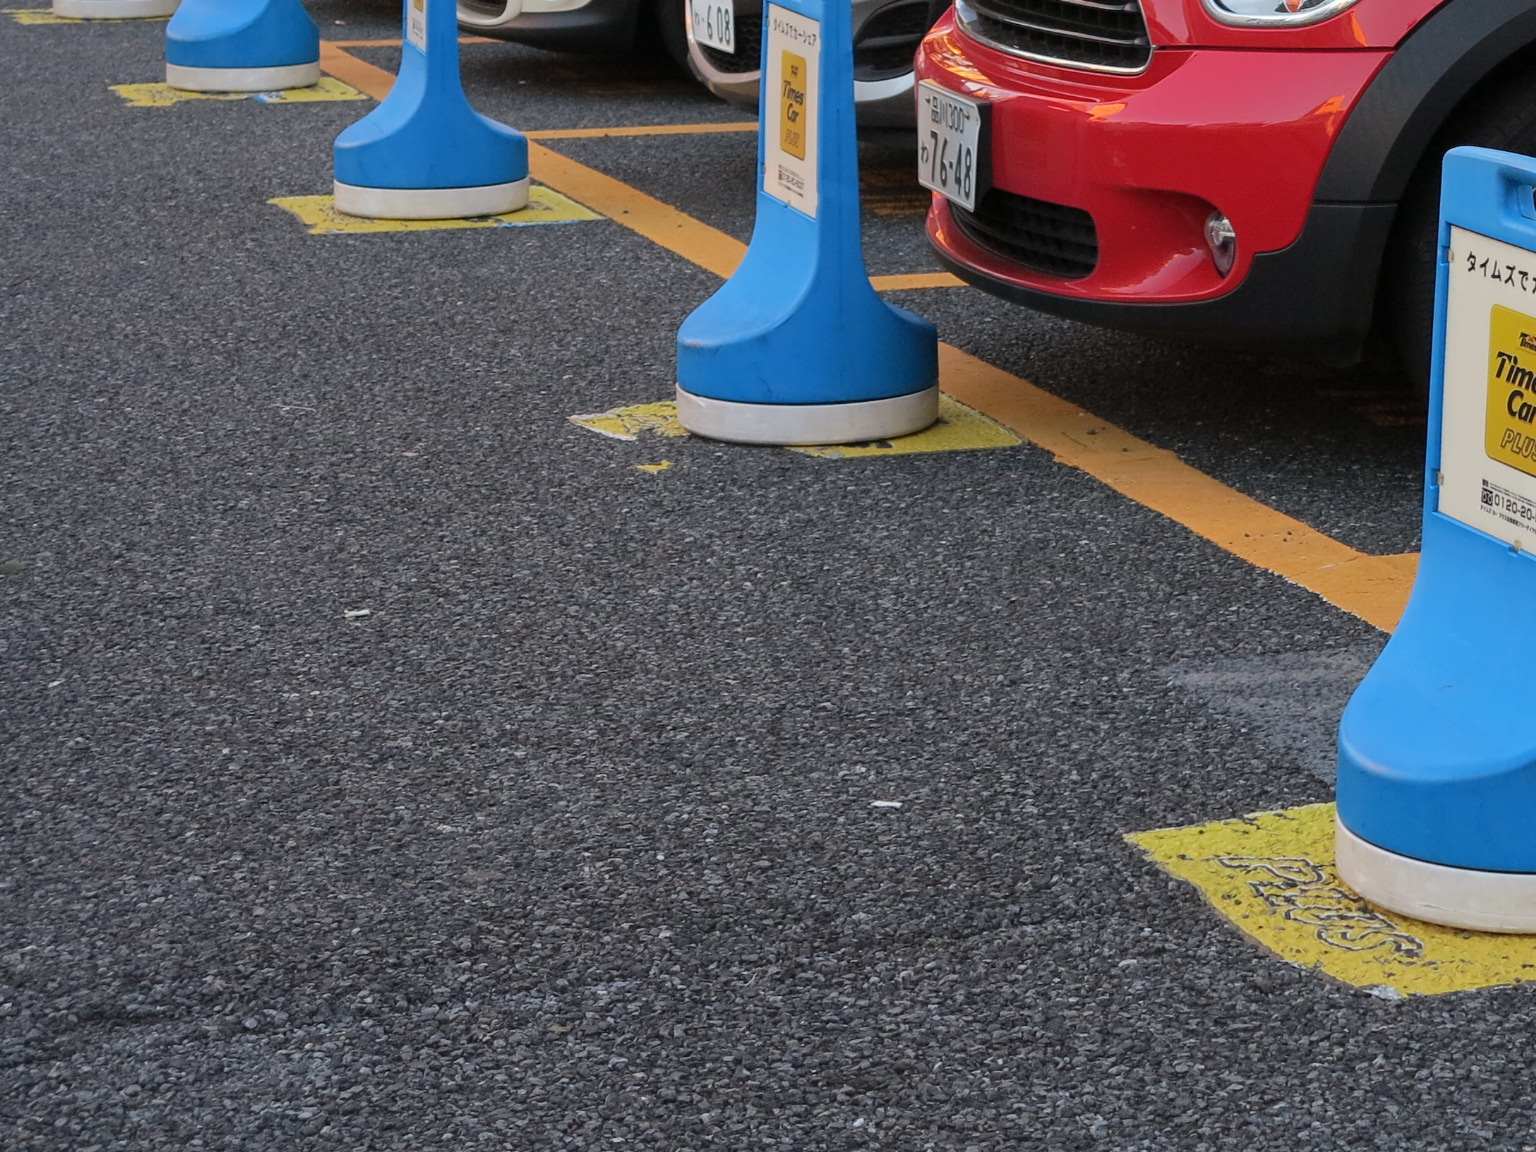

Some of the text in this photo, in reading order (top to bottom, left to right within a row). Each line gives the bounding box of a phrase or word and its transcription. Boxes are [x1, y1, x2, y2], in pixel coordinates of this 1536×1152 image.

[774, 17, 817, 47] タイムズでカーシェア
[783, 80, 805, 106] Times
[786, 102, 800, 123] Car
[930, 130, 972, 201] 76-48
